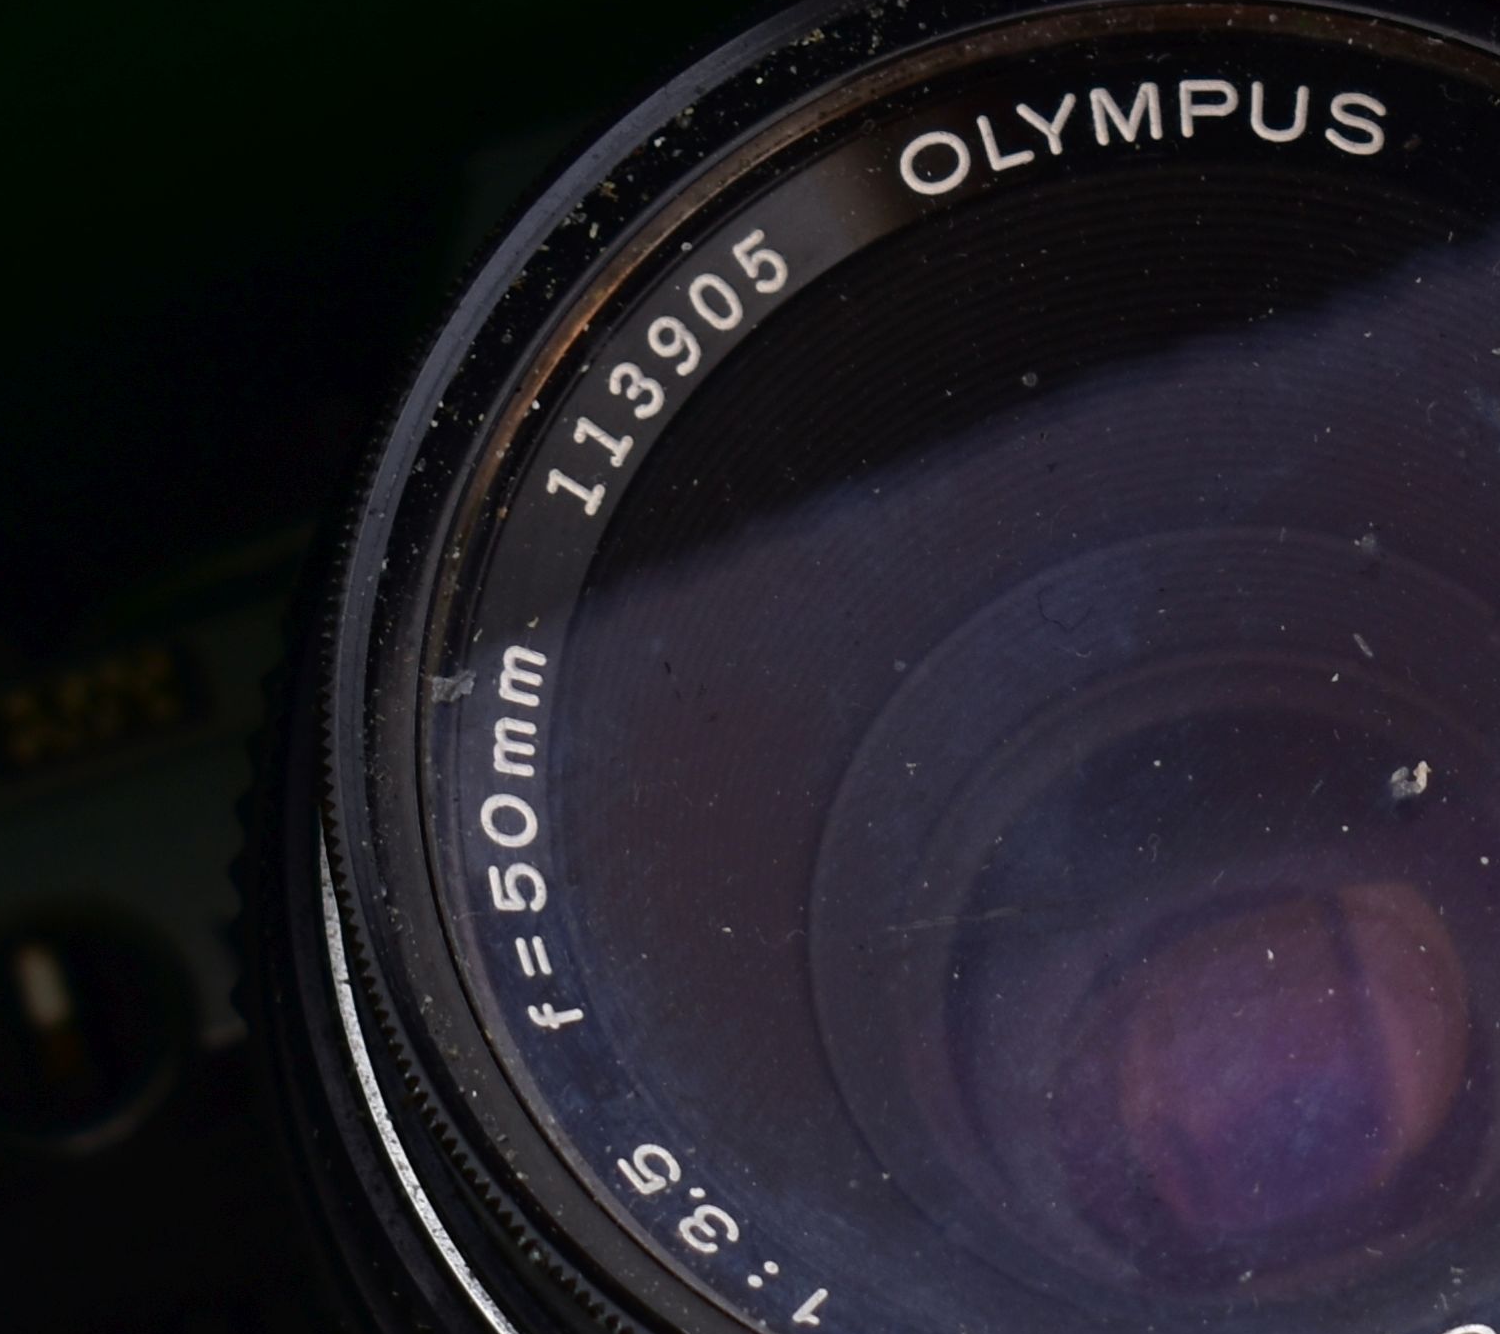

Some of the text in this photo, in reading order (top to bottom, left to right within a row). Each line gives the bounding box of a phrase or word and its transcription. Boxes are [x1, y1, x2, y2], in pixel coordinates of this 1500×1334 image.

[898, 78, 1388, 197] OLYMPUS
[545, 228, 789, 517] 113905
[479, 645, 584, 1030] f=50mm
[616, 1142, 829, 1328] 1:3.5
